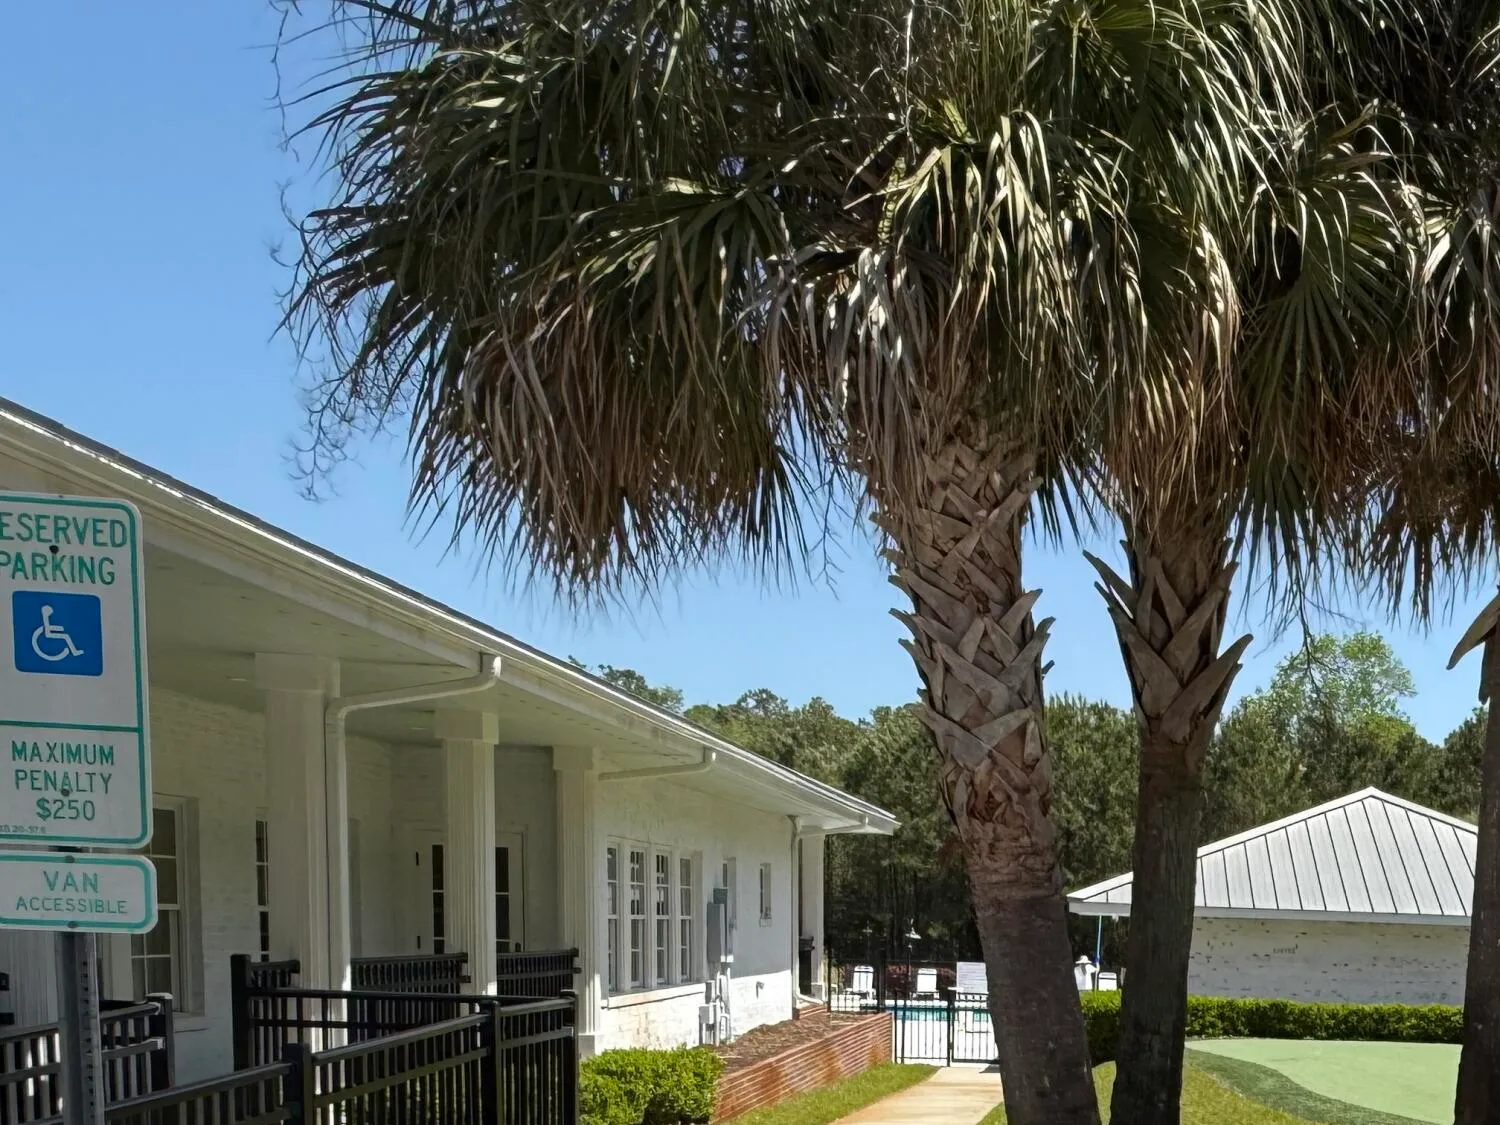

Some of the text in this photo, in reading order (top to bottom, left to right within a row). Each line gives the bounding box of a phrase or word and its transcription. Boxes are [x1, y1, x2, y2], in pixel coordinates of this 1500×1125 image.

[0, 512, 128, 548] ESERVED
[0, 550, 115, 585] PARKING
[11, 740, 115, 766] MAXIMUM
[15, 769, 112, 794] PENALTY
[36, 797, 96, 821] $250
[43, 870, 99, 893] VAN
[15, 896, 128, 914] ACCESSIBLE
